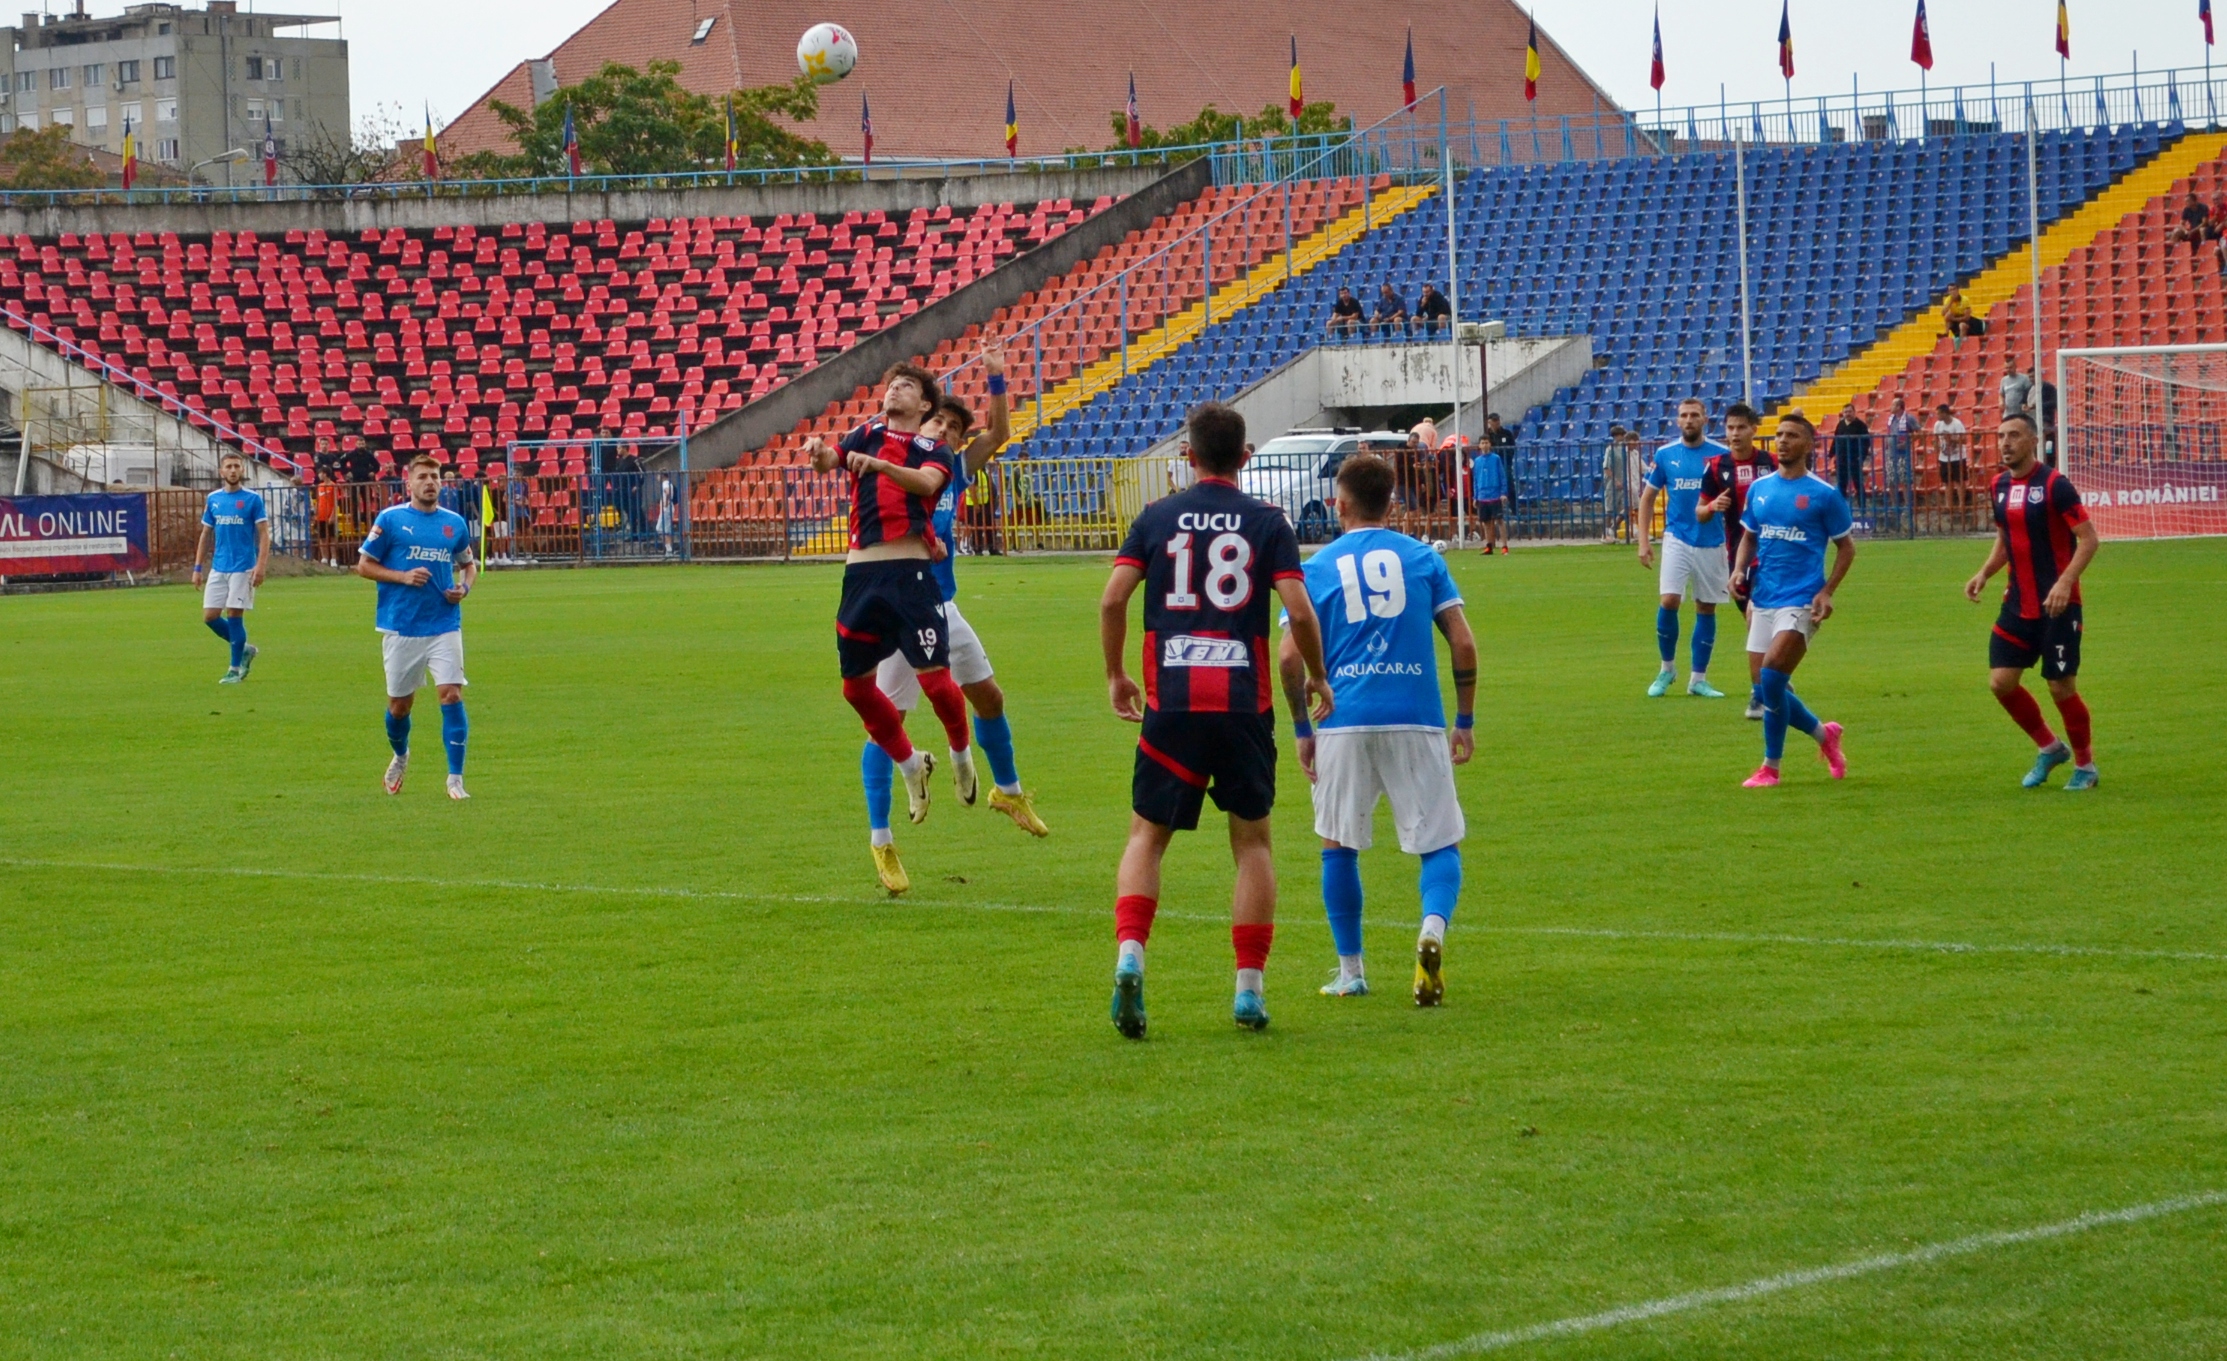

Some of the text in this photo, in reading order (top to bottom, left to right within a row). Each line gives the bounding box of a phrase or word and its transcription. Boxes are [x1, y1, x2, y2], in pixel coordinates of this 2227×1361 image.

[2117, 483, 2218, 506] ROMÂNIEI
[0, 510, 128, 538] AL ONLINE
[1177, 512, 1242, 531] CUCU
[1166, 532, 1255, 611] 18
[1336, 549, 1407, 624] 19
[917, 628, 937, 646] 19
[2055, 645, 2065, 659] 7
[1335, 662, 1423, 679] AQUACARAS
